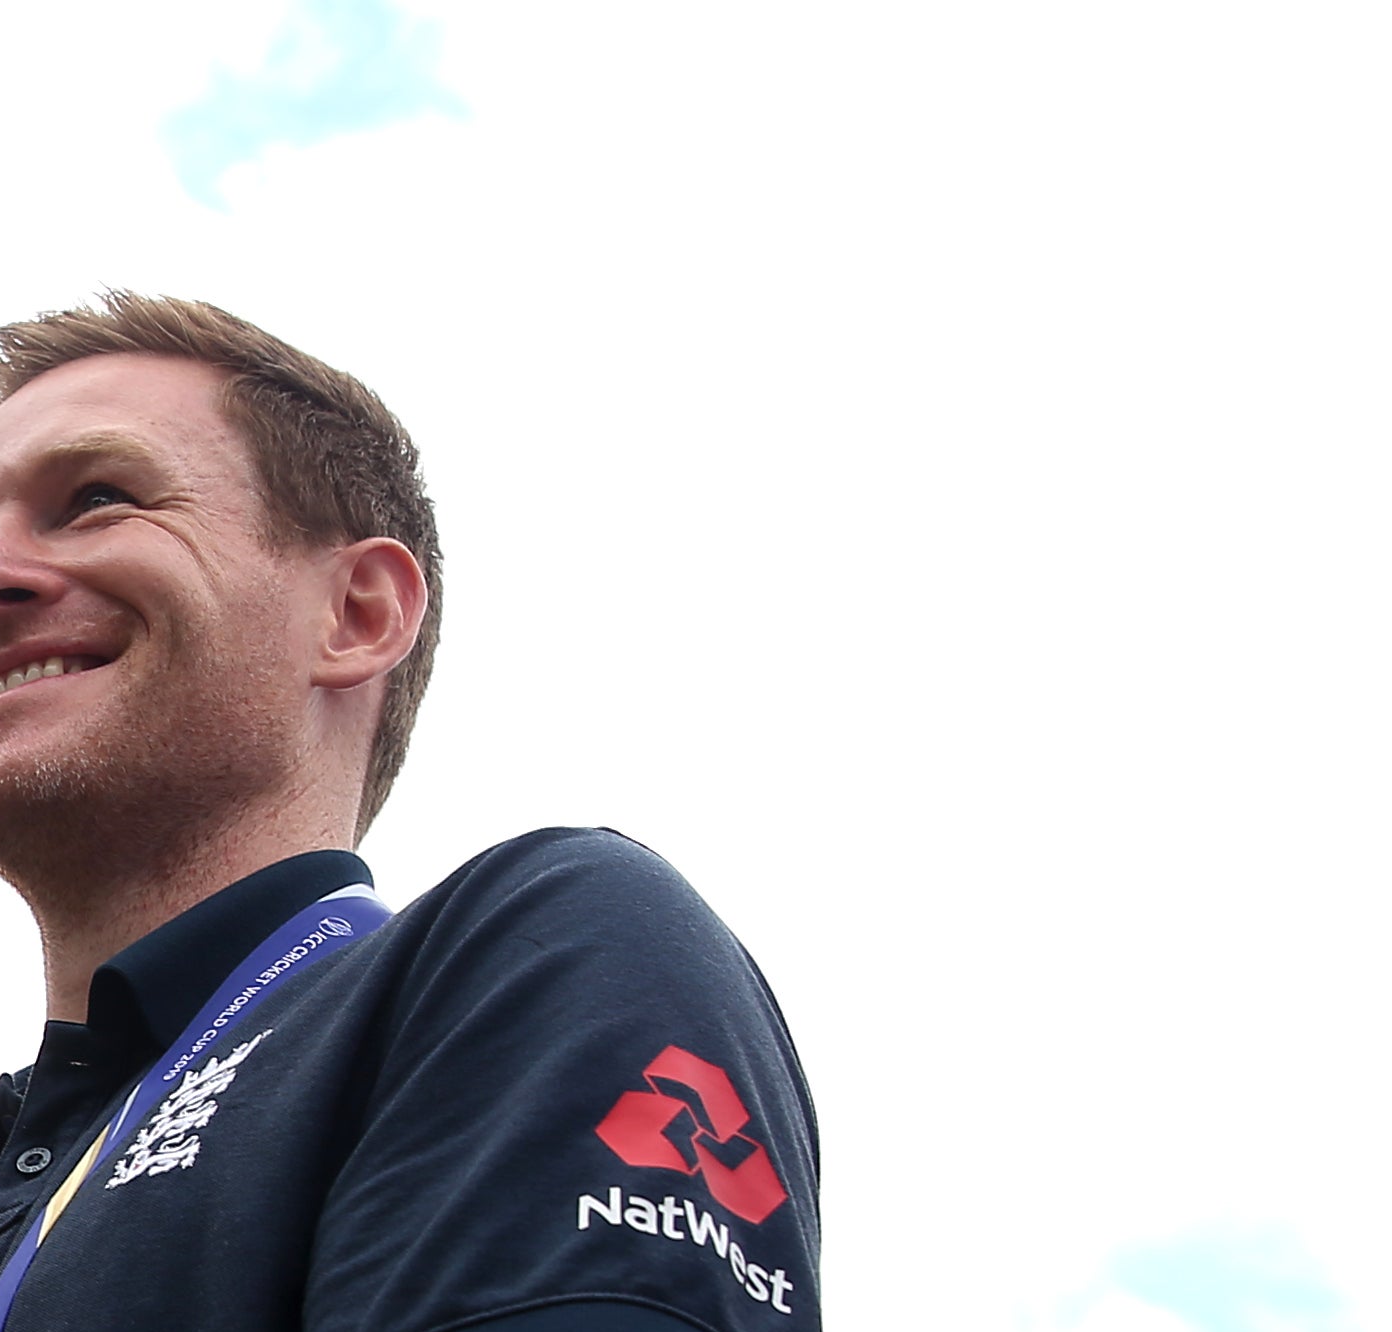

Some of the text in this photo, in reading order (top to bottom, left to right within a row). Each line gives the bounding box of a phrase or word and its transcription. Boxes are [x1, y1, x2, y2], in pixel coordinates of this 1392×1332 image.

[163, 931, 327, 1081] ICC CRICKET WORLD CUP 2019
[577, 1186, 794, 1314] NatWest
